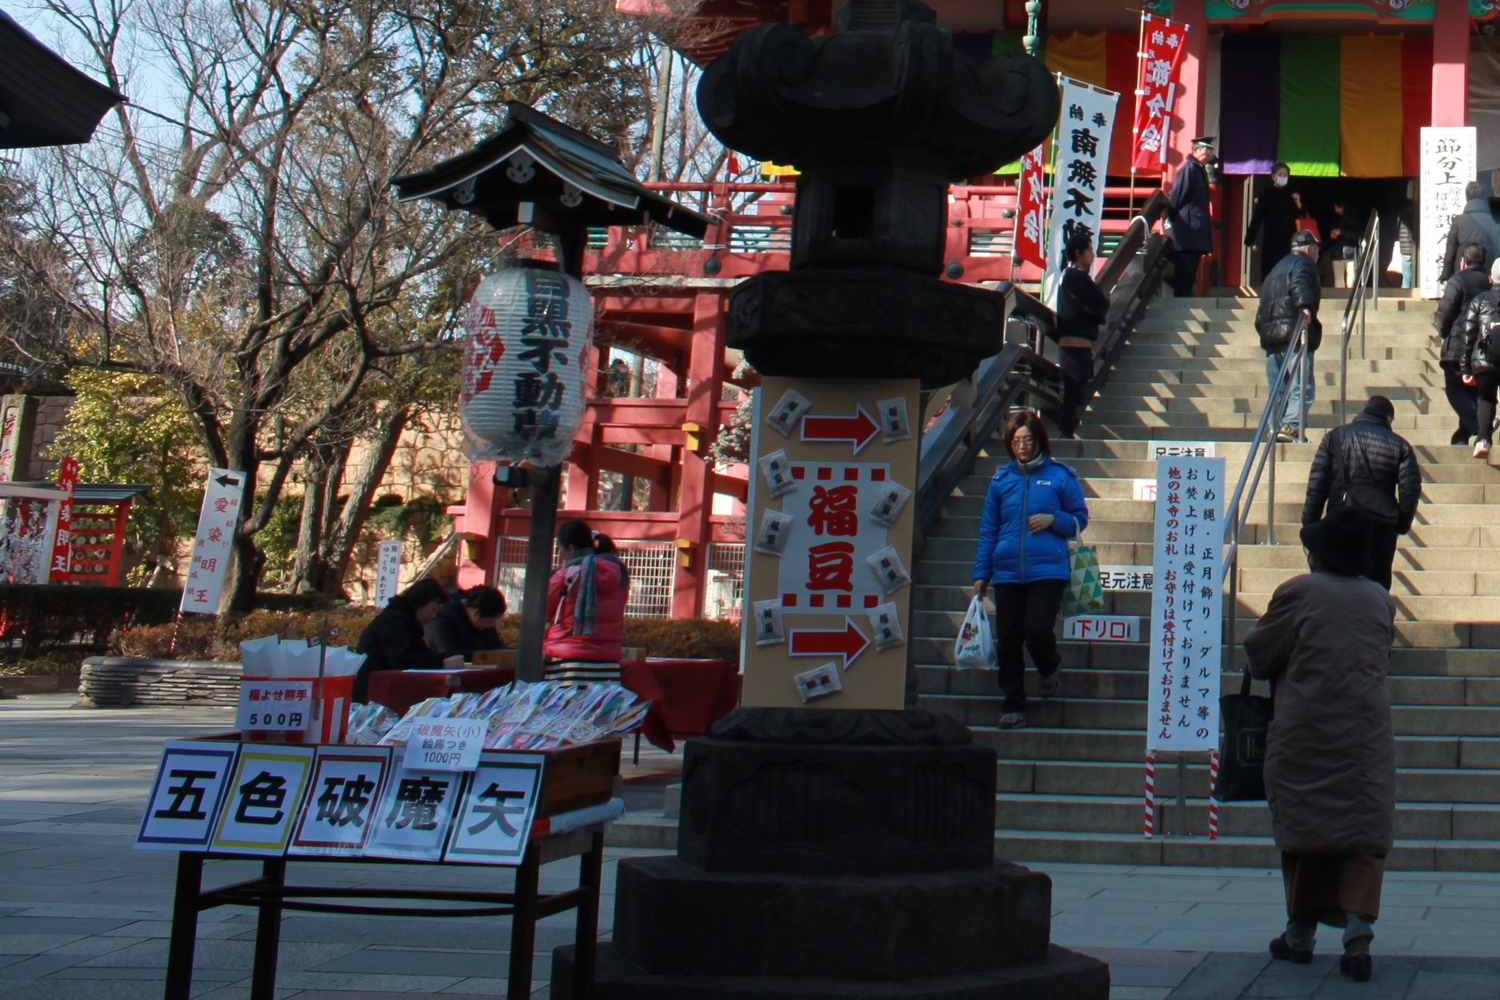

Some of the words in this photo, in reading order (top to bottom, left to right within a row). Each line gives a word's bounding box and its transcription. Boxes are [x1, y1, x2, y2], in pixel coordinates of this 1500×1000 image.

[193, 496, 230, 603] 愛染明王
[806, 484, 859, 593] 福豆
[1100, 572, 1154, 591] 足元注意
[1158, 466, 1182, 739] 他の社寺のお札・お守りは受付けておりません
[1177, 468, 1199, 728] お焚上げは受付けておりません
[1196, 469, 1216, 739] しめ縄・正月飾り・ダルマ等の
[248, 688, 308, 702] 福よせ熊手
[422, 738, 468, 751] 絵馬つき
[423, 751, 462, 765] 1000円
[154, 769, 527, 838] 五色破魔矢
